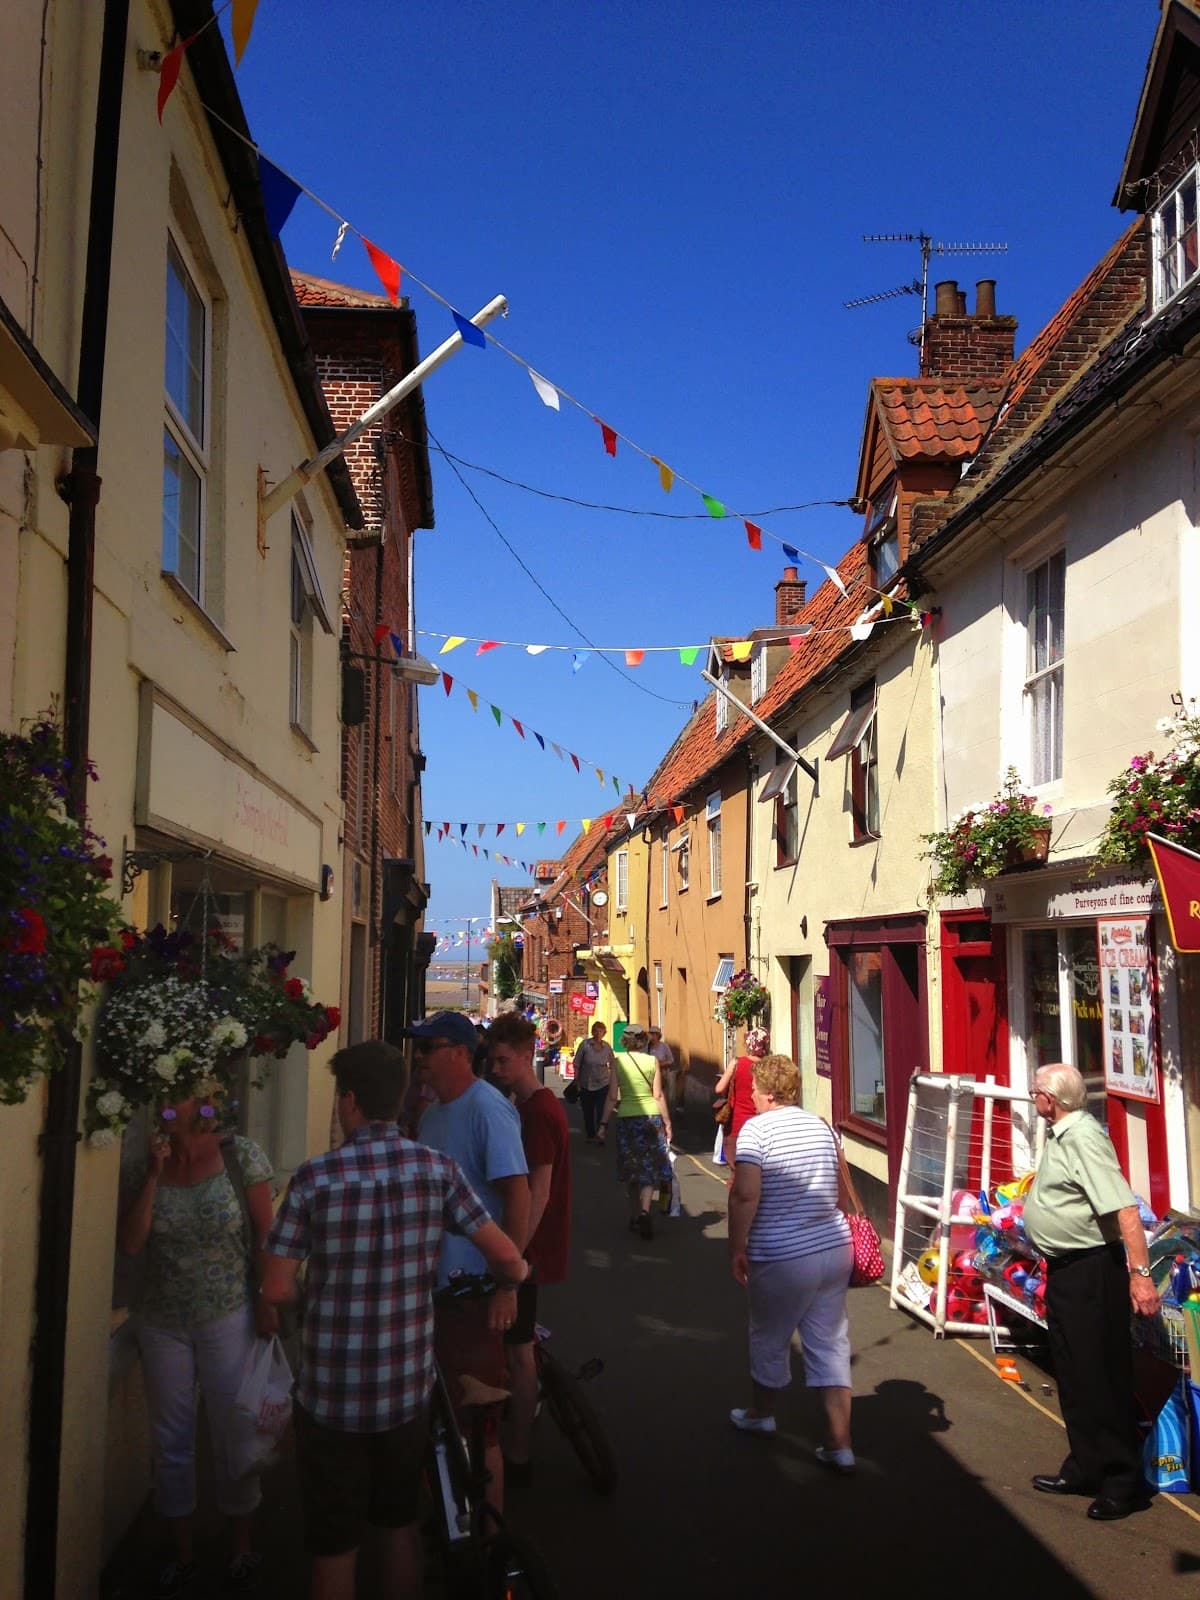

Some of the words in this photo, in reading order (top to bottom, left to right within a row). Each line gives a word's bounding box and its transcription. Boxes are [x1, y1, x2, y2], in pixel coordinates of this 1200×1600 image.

[1075, 896, 1108, 912] Purveyors
[1110, 895, 1118, 906] of
[1120, 893, 1134, 905] fine
[1100, 948, 1116, 968] ICE
[1072, 999, 1088, 1019] Pick
